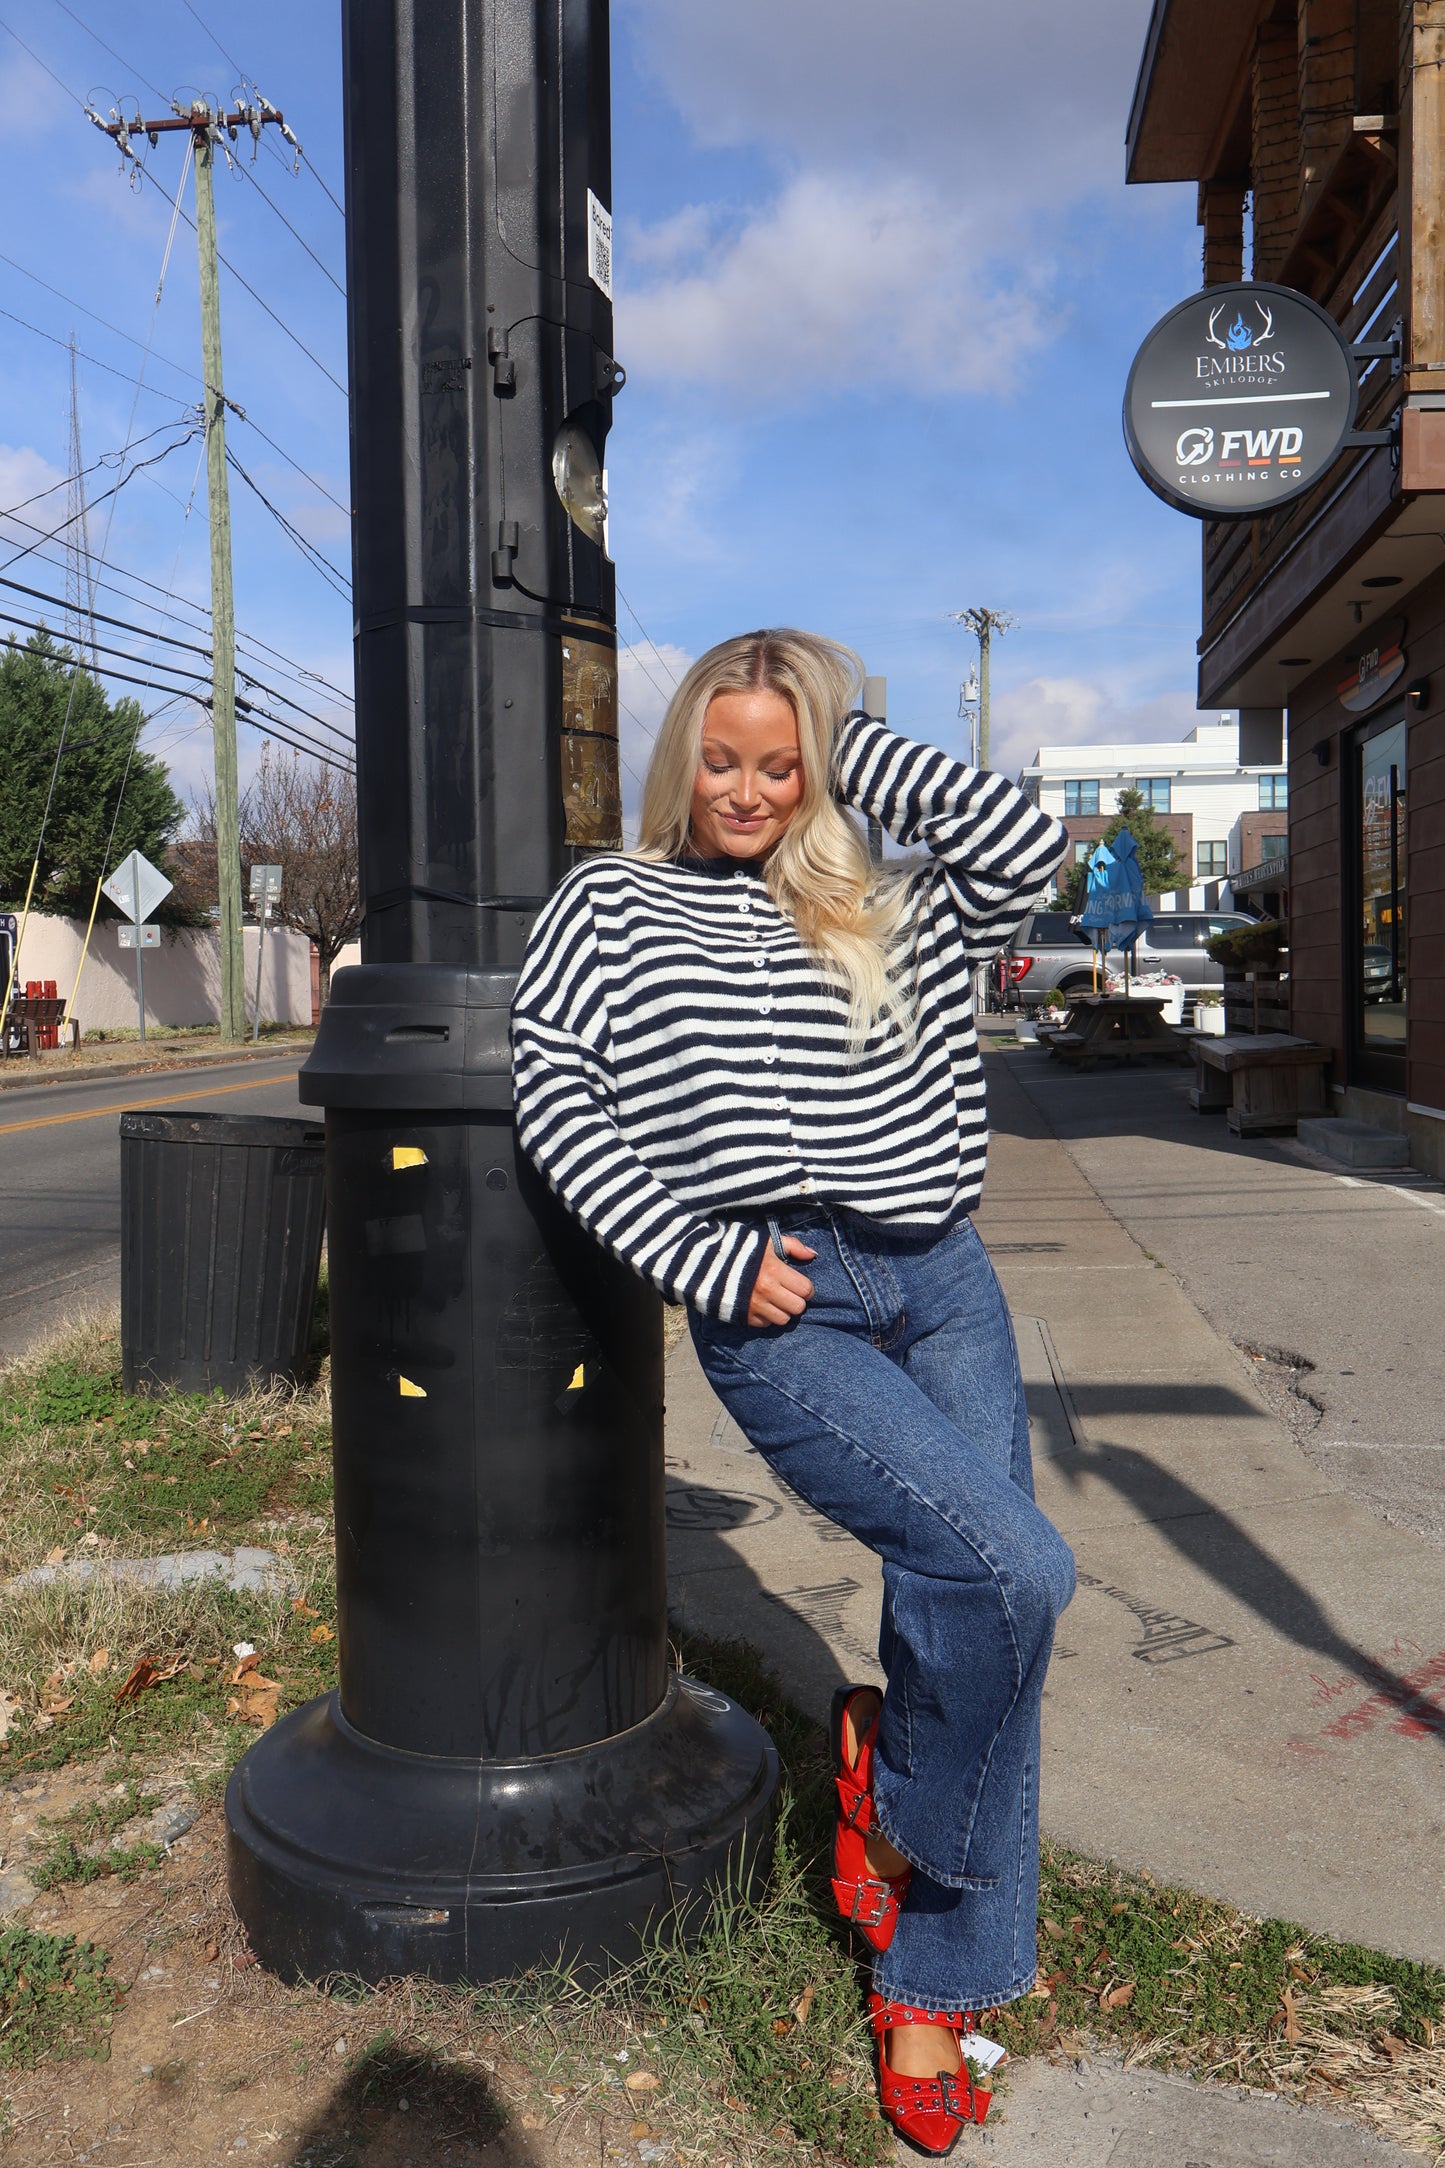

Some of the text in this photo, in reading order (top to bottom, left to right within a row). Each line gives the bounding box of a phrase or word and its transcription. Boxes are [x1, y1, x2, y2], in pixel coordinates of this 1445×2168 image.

[592, 203, 612, 241] Bored
[1196, 351, 1286, 378] EMBERS
[1205, 375, 1273, 389] SKI LODGE
[1220, 426, 1304, 459] FWD
[1179, 468, 1302, 484] CLOTHING CO
